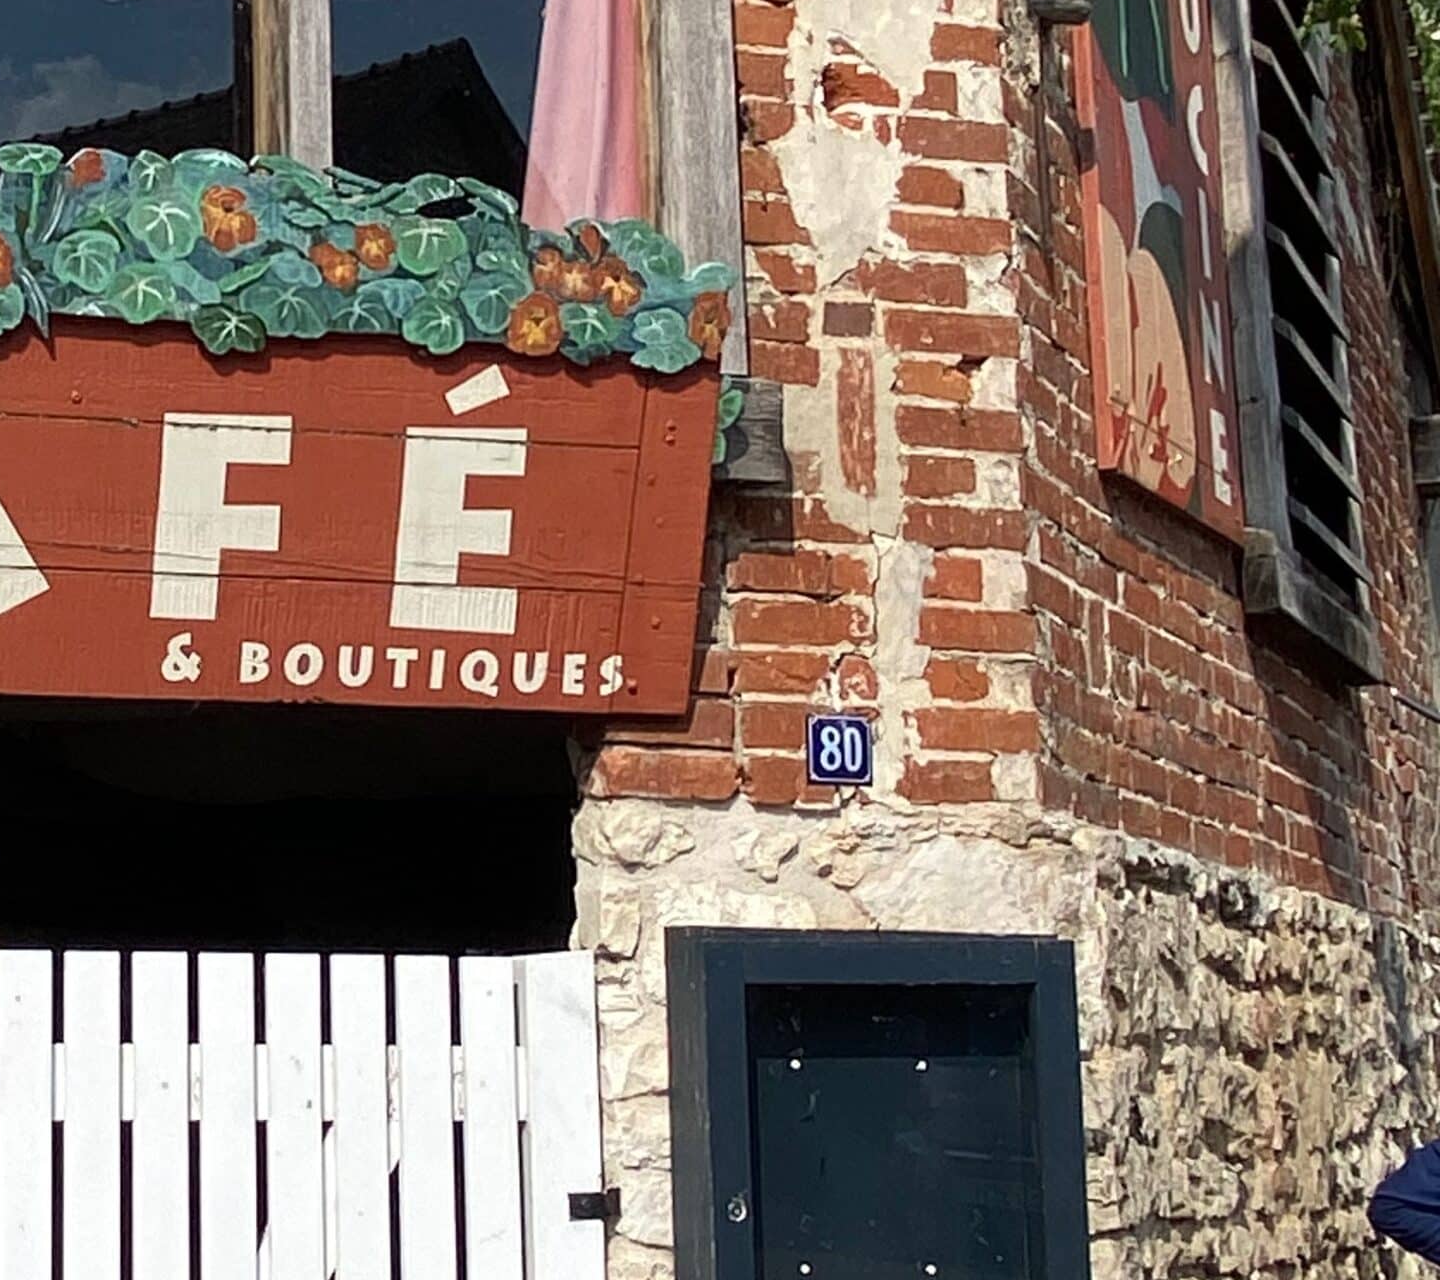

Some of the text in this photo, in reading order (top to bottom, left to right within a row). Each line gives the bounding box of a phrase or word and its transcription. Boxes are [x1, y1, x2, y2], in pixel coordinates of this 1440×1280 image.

[160, 631, 625, 699] & BOUTIQUES
[817, 726, 864, 773] 80
